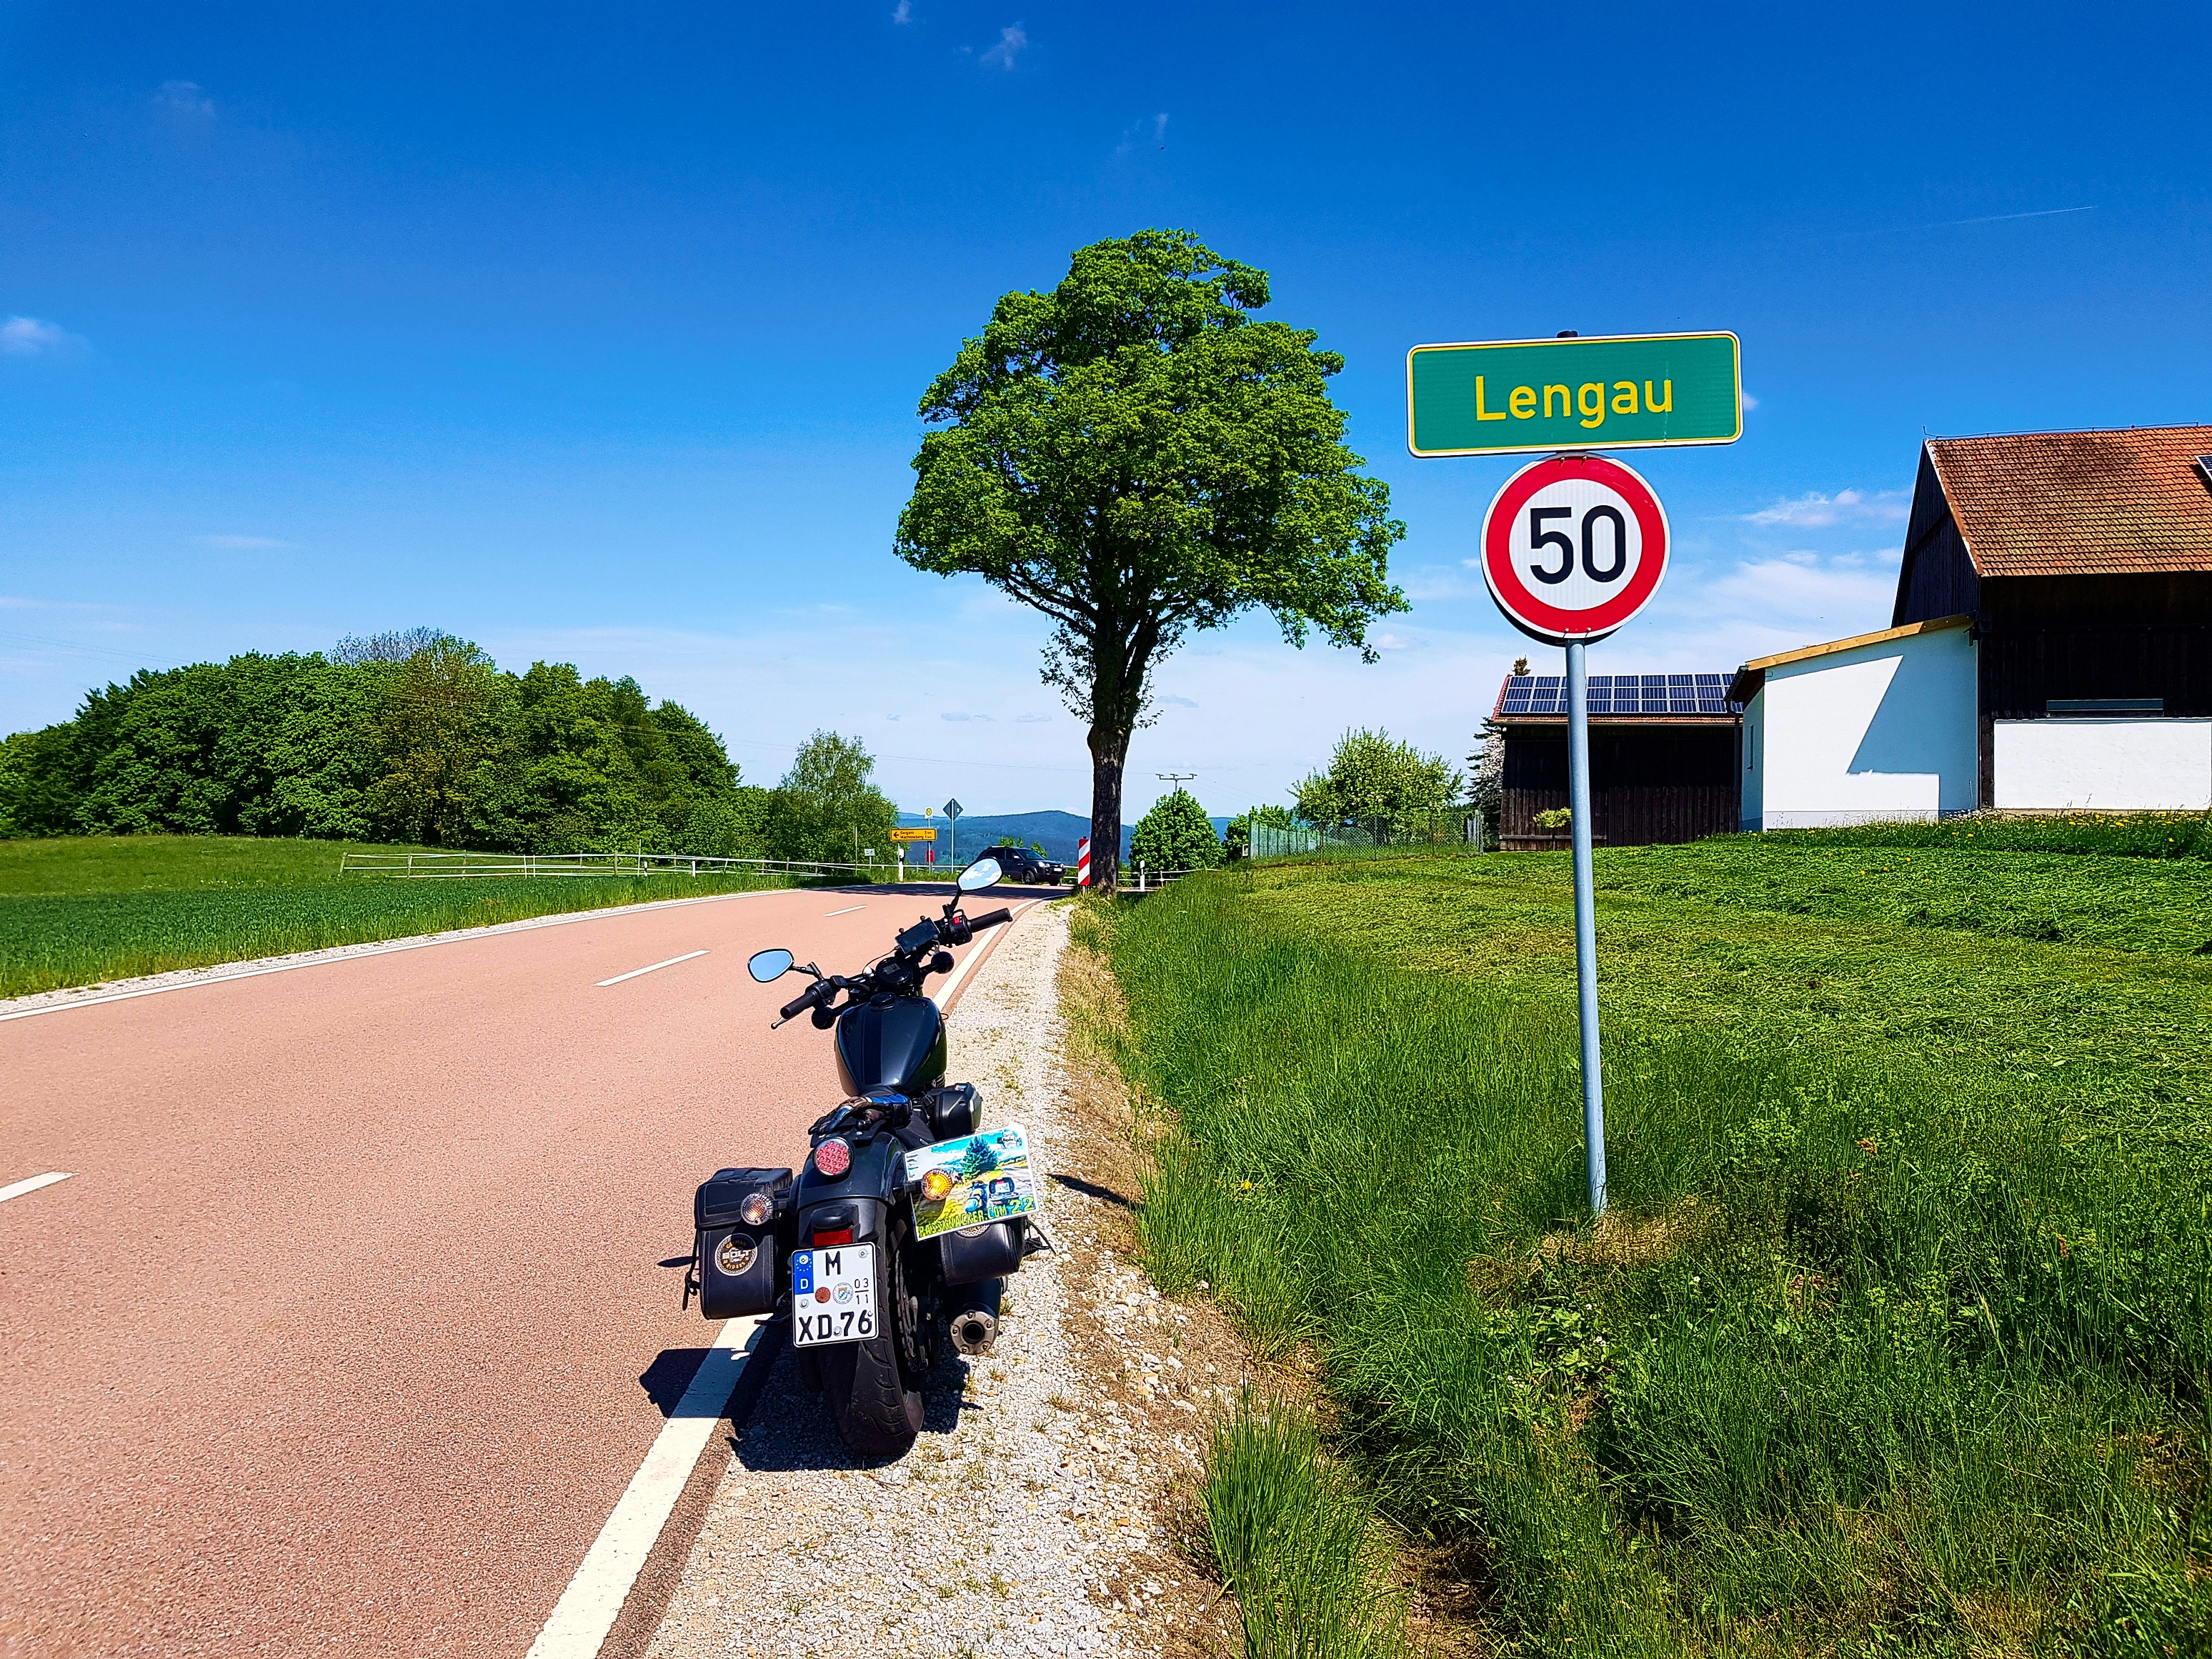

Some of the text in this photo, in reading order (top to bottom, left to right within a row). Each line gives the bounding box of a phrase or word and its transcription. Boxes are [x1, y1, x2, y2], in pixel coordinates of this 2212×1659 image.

[1475, 375, 1673, 429] Lengau
[1530, 504, 1626, 584] 50
[1009, 1196, 1035, 1215] 22
[722, 1250, 752, 1260] BOLT
[726, 1261, 746, 1270] RIDERS
[825, 1250, 841, 1276] M
[800, 1278, 809, 1290] D
[855, 1277, 869, 1289] 03
[856, 1294, 869, 1305] 11
